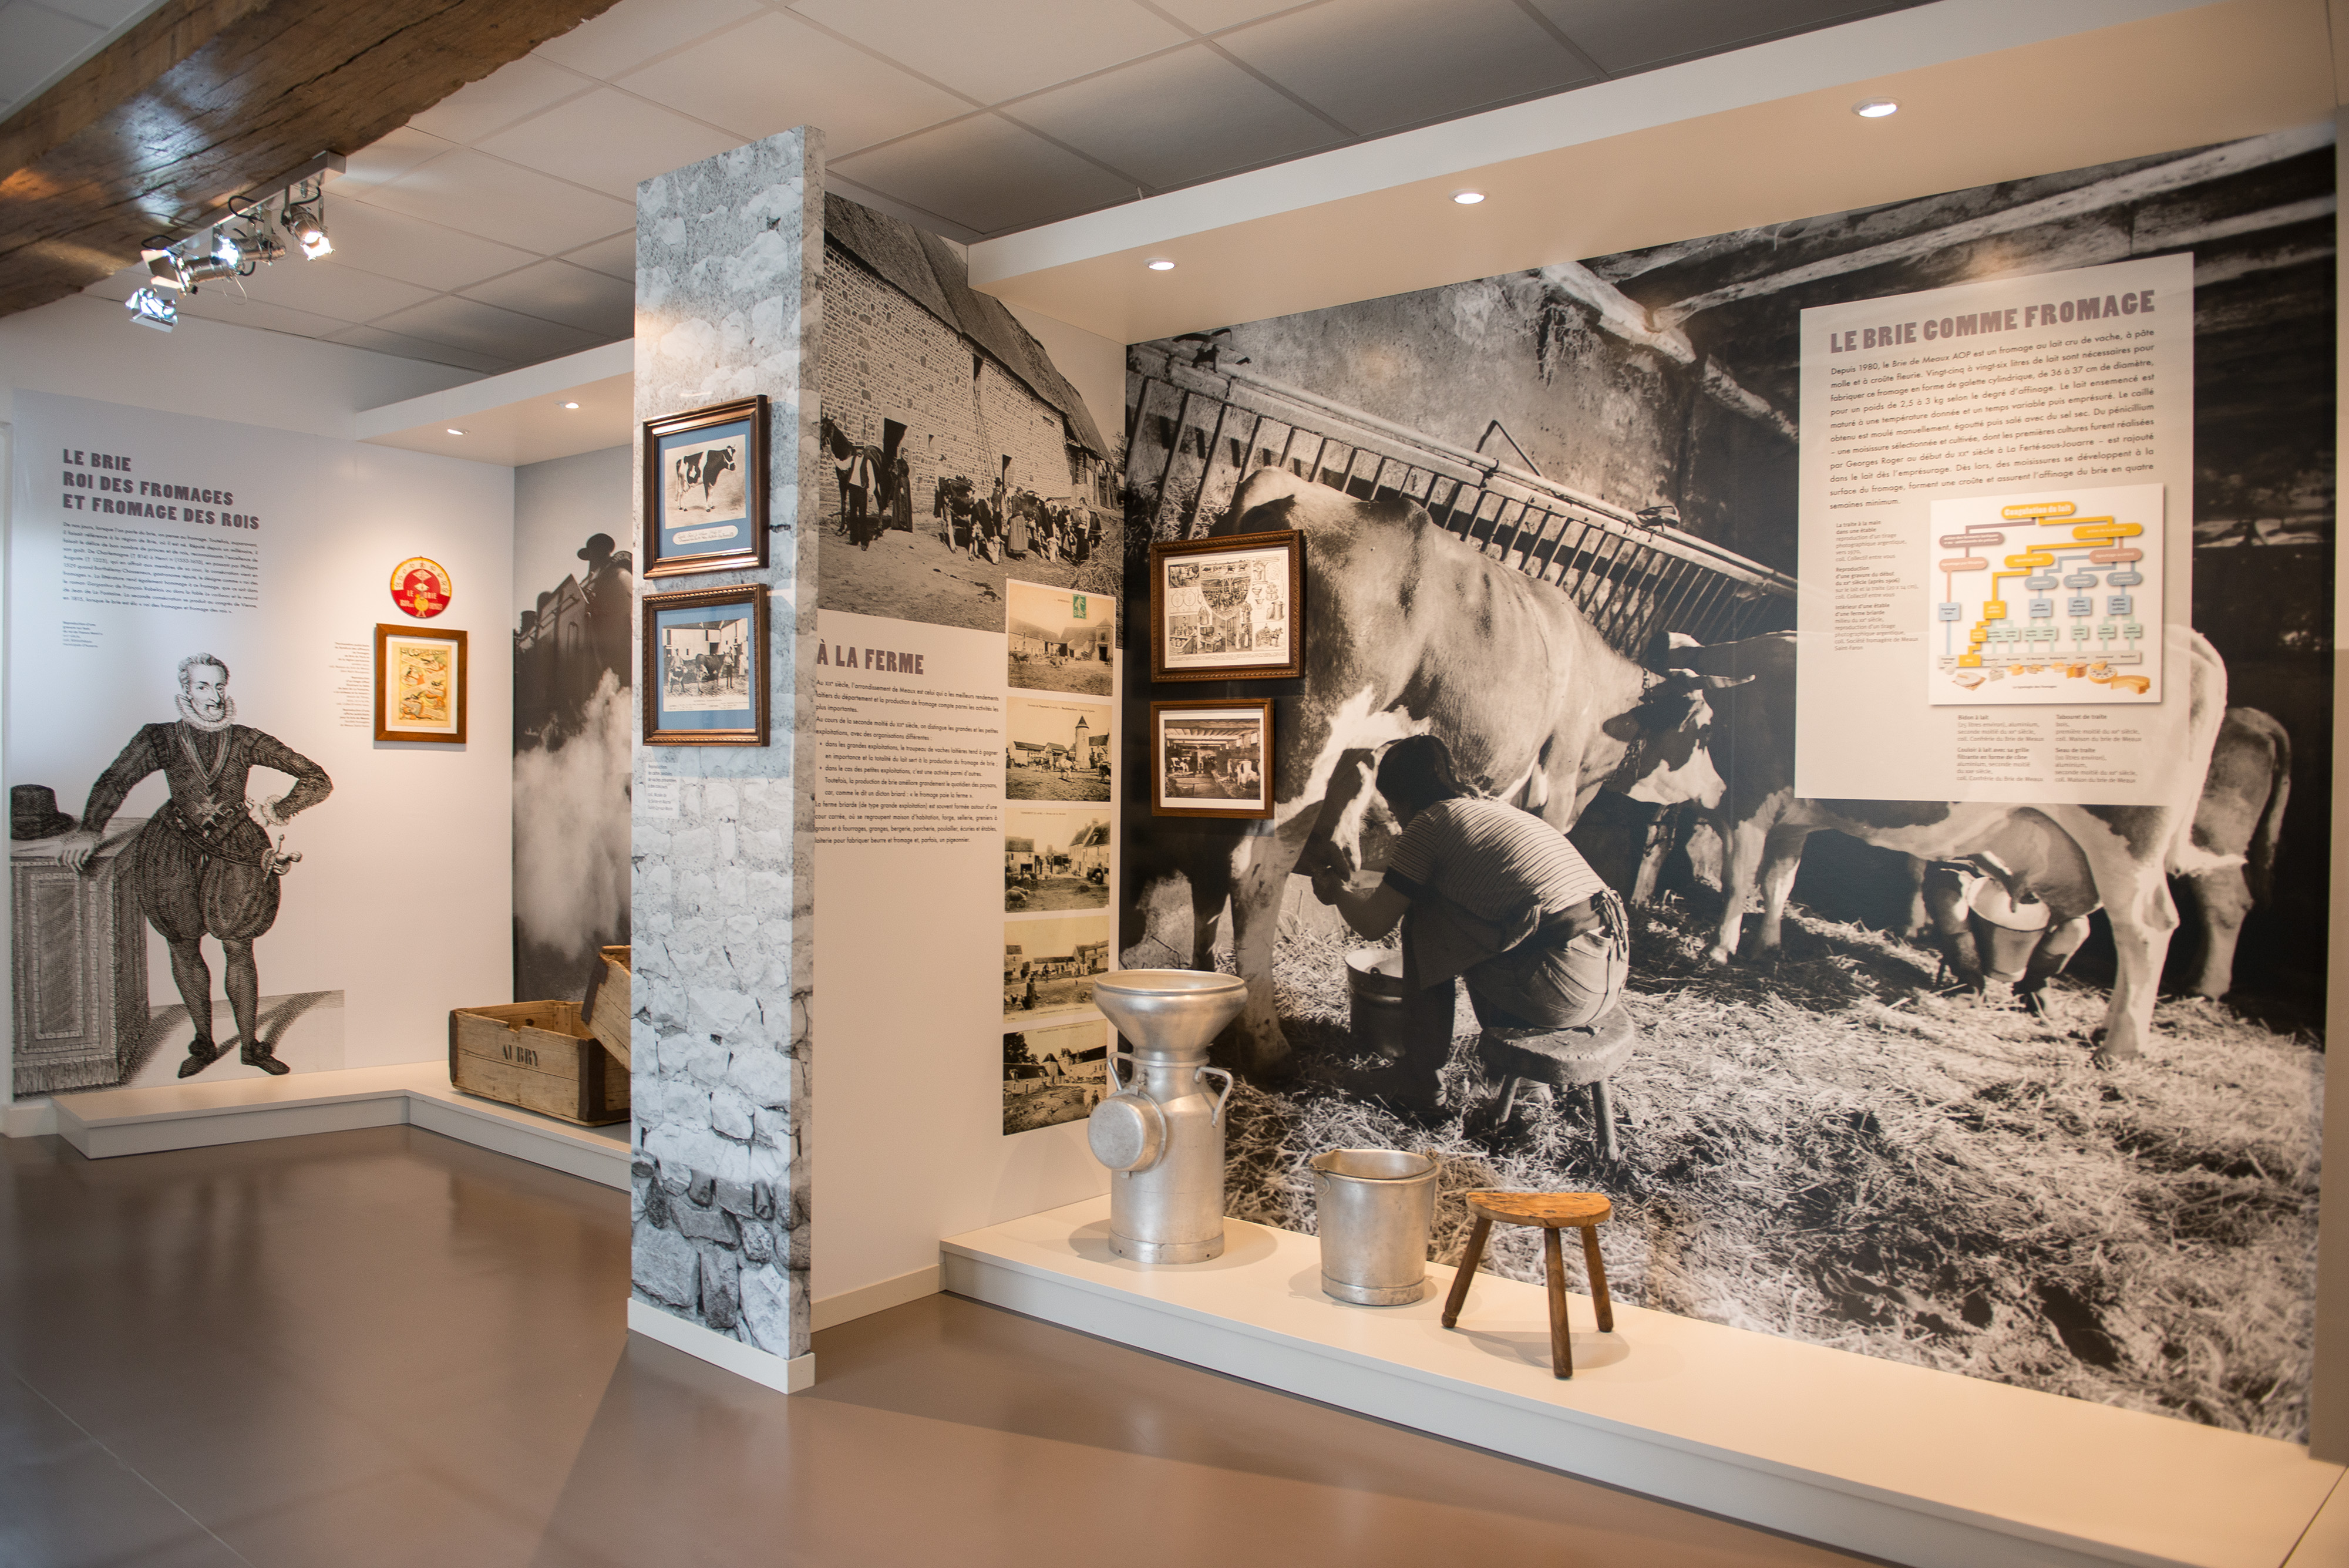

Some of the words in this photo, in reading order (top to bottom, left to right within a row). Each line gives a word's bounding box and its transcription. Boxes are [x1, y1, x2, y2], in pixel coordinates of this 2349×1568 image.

[1830, 330, 1857, 354] LE
[1863, 321, 1917, 349] BRIE
[1923, 308, 2018, 341] COMME
[2025, 290, 2155, 328] FROMAGE
[1830, 366, 1856, 376] Depuis
[1859, 362, 1880, 371] 1980,
[1892, 359, 1907, 368] Brie
[1909, 357, 1920, 365] de
[1952, 351, 1971, 360] AOP
[1999, 345, 2034, 354] fromage
[2050, 339, 2062, 348] lait
[2081, 336, 2092, 344] de
[2094, 332, 2123, 342] vache,
[2134, 329, 2155, 340] pâte
[1830, 379, 1851, 388] molle
[1870, 375, 1894, 383] croûte
[1896, 371, 1923, 381] fleurie.
[1926, 367, 1964, 378] Vingt-cinq
[1976, 361, 2008, 372] vingt-six
[2062, 353, 2079, 361] sont
[2082, 347, 2131, 358] nécessaires
[2133, 345, 2155, 355] pour
[1830, 393, 1865, 402] fabriquer
[1877, 388, 1909, 396] fromage
[1947, 381, 1957, 389] de
[1958, 378, 1986, 389] galette
[1988, 374, 2035, 385] cylindrique,
[2038, 370, 2048, 378] de
[2051, 368, 2062, 376] 36
[2072, 365, 2084, 374] 37
[2099, 363, 2111, 371] de
[2113, 359, 2154, 369] diamètre,
[1830, 409, 1849, 417] pour
[1863, 402, 1884, 413] poids
[1887, 401, 1897, 409] de
[1900, 399, 1913, 408] 2,5
[1934, 396, 1944, 405] kg
[1947, 394, 1968, 402] selon
[1982, 389, 2006, 399] degré
[2010, 385, 2056, 396] d'affinage.
[2089, 375, 2138, 387] ensemencé
[63, 448, 84, 466] LE
[91, 452, 131, 472] BRIE
[63, 471, 93, 489] ROI
[100, 476, 133, 493] DES
[140, 480, 233, 506] FROMAGES
[1829, 501, 1863, 510] semaines
[63, 493, 85, 510] ET
[92, 497, 177, 520] FROMAGE
[183, 507, 215, 524] DES
[221, 512, 259, 530] ROIS
[816, 638, 829, 665] À
[836, 645, 858, 668] LA
[865, 648, 924, 675] FERME
[815, 703, 827, 711] plus
[827, 704, 859, 713] importantes.
